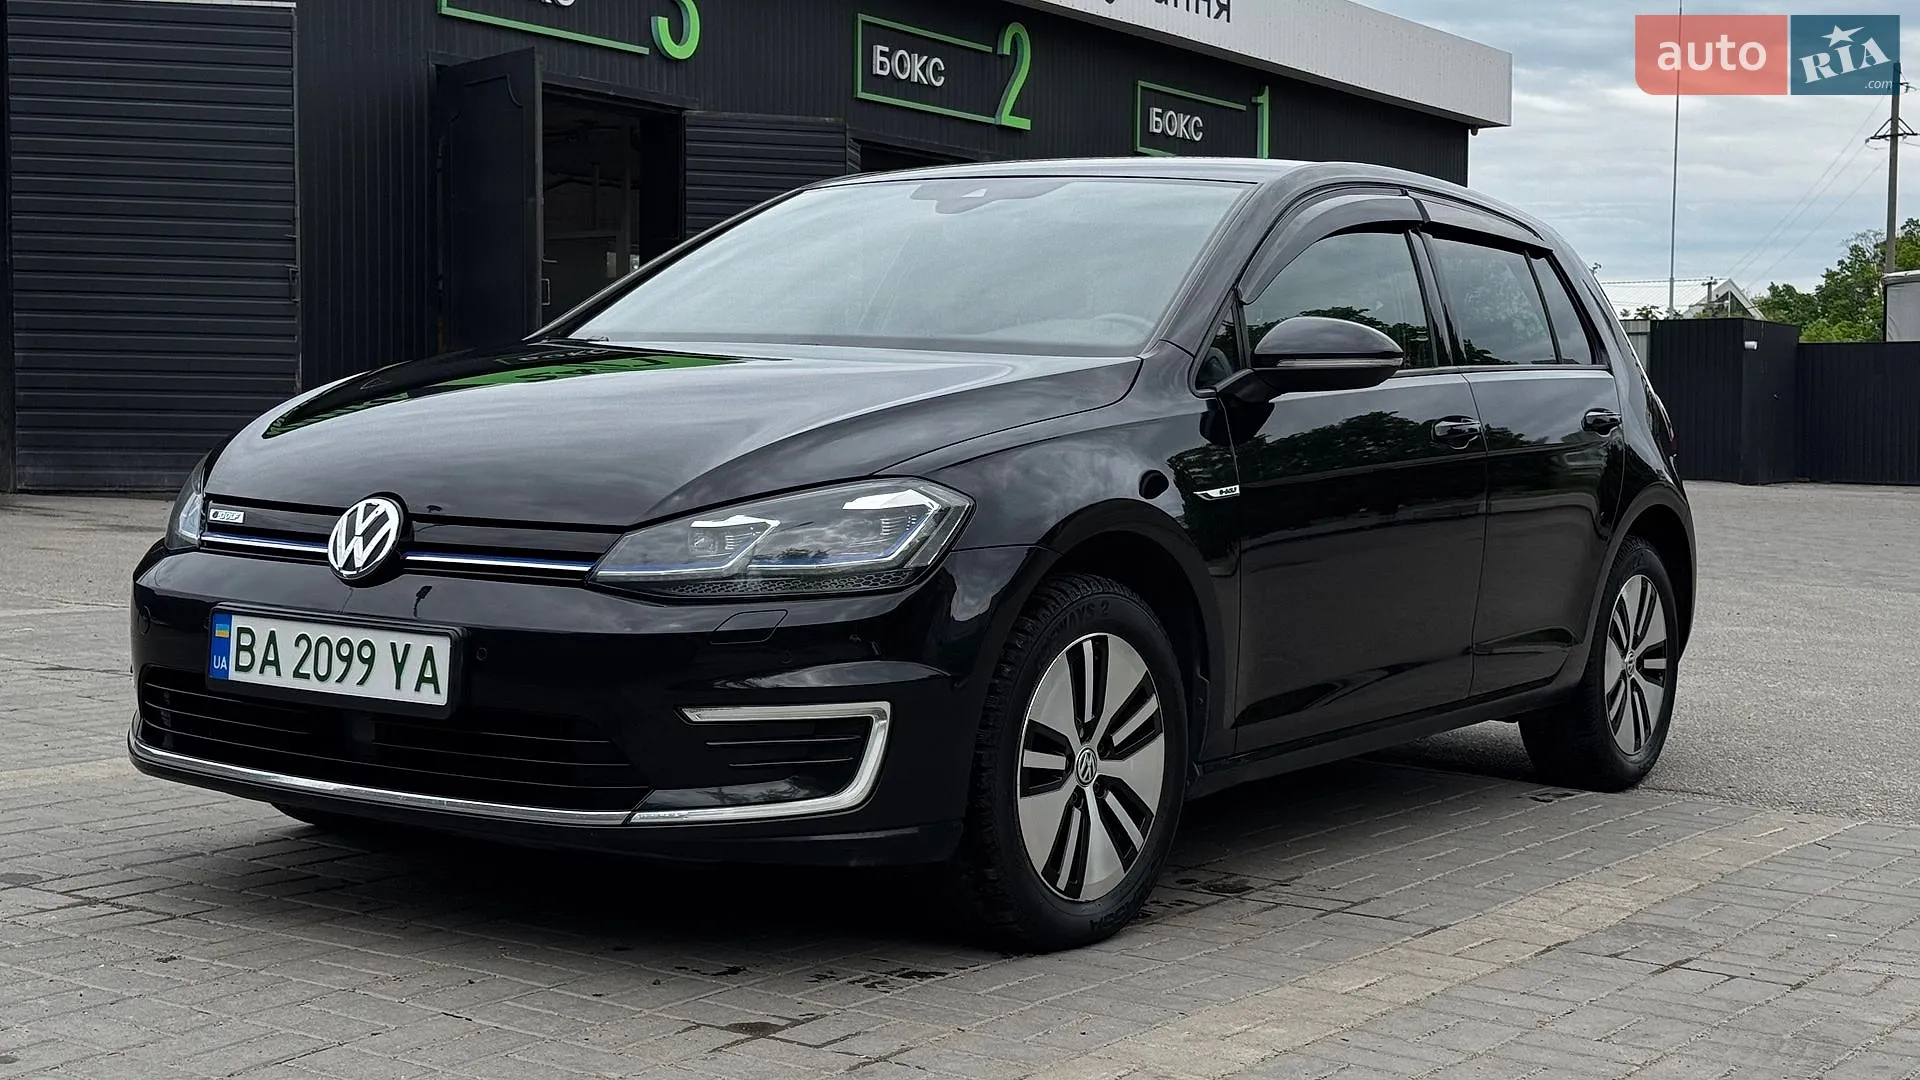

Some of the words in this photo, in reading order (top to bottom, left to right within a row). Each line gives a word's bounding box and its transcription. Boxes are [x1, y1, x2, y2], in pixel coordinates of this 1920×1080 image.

[872, 44, 945, 87] БОКС
[997, 21, 1032, 131] 2
[1149, 107, 1204, 142] БОКС
[1251, 85, 1270, 159] 1
[213, 655, 228, 670] UA
[234, 626, 282, 677] BA
[292, 632, 376, 686] 2099
[389, 641, 441, 694] YA
